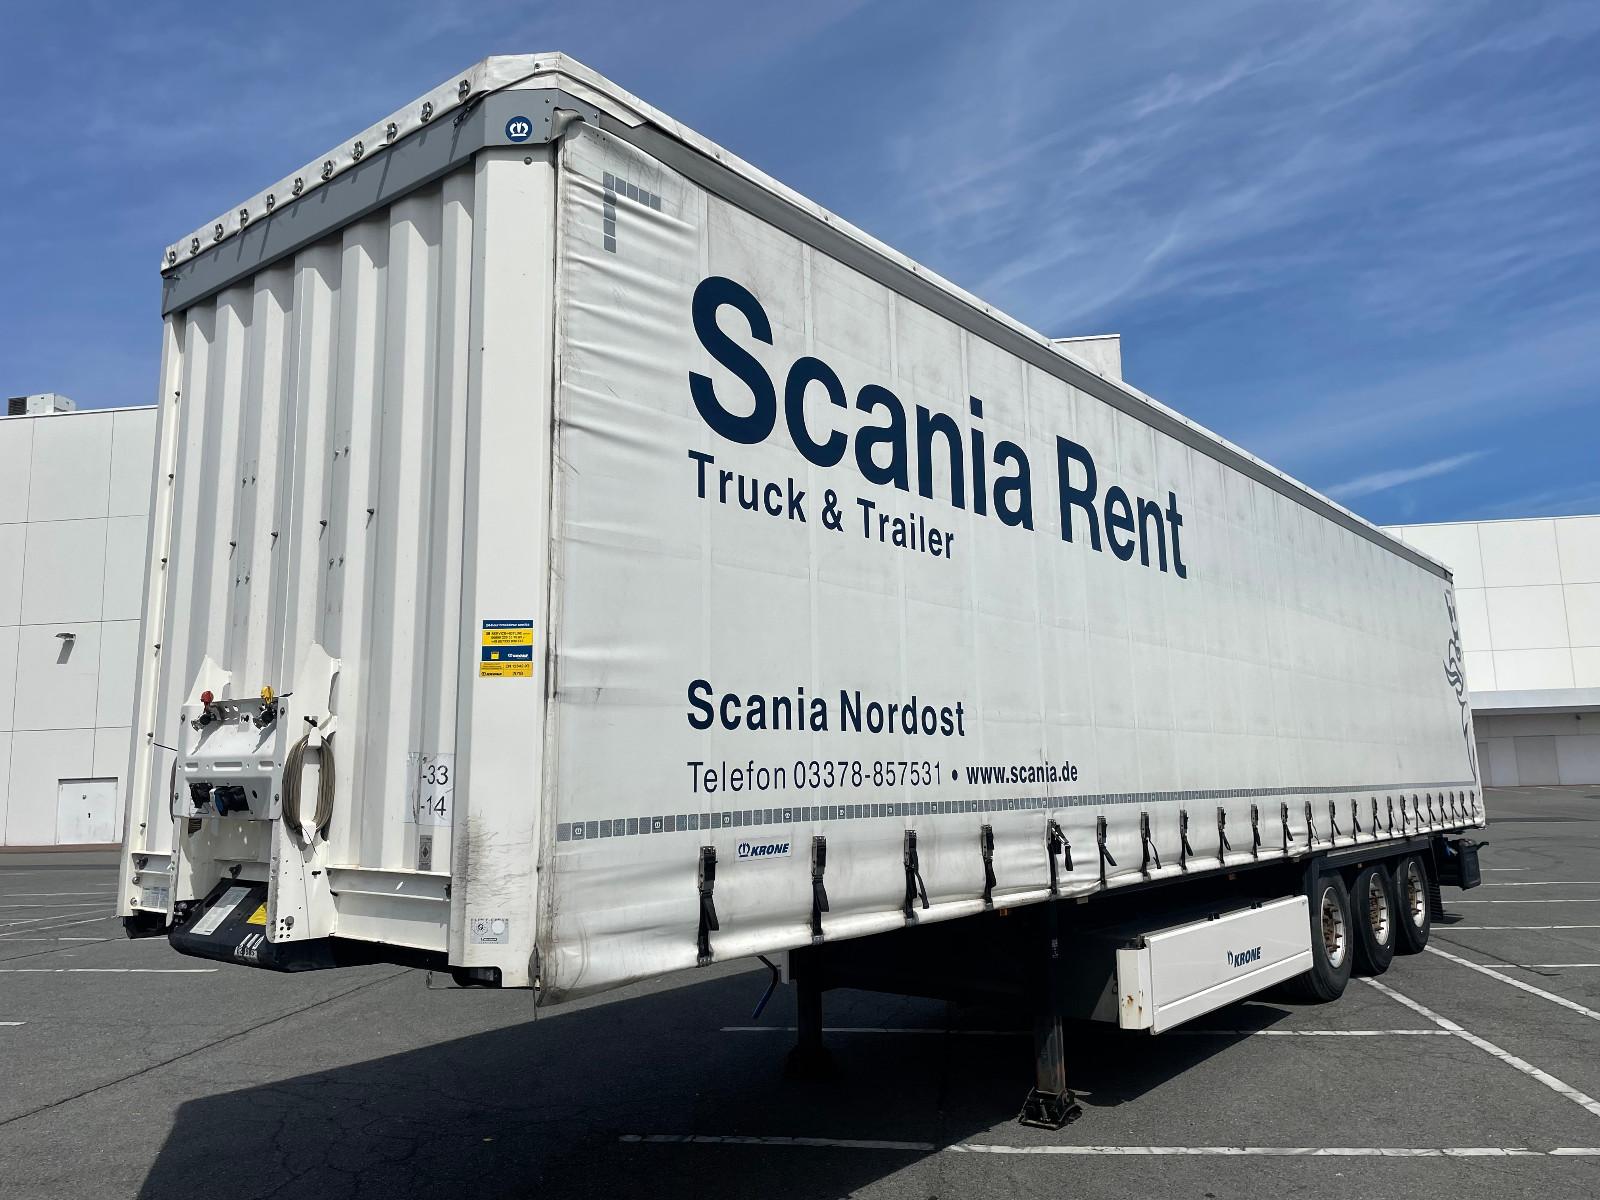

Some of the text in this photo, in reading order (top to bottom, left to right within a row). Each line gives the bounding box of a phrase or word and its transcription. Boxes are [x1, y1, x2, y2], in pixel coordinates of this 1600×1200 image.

[689, 276, 1188, 579] Scania Rent
[688, 450, 955, 559] Truck & Trailer
[687, 679, 965, 737] Scania Nordost
[687, 760, 1078, 794] Telefon 03378-857531 www.scania.de
[750, 843, 790, 857] KRONE
[1233, 946, 1262, 968] KRONE
